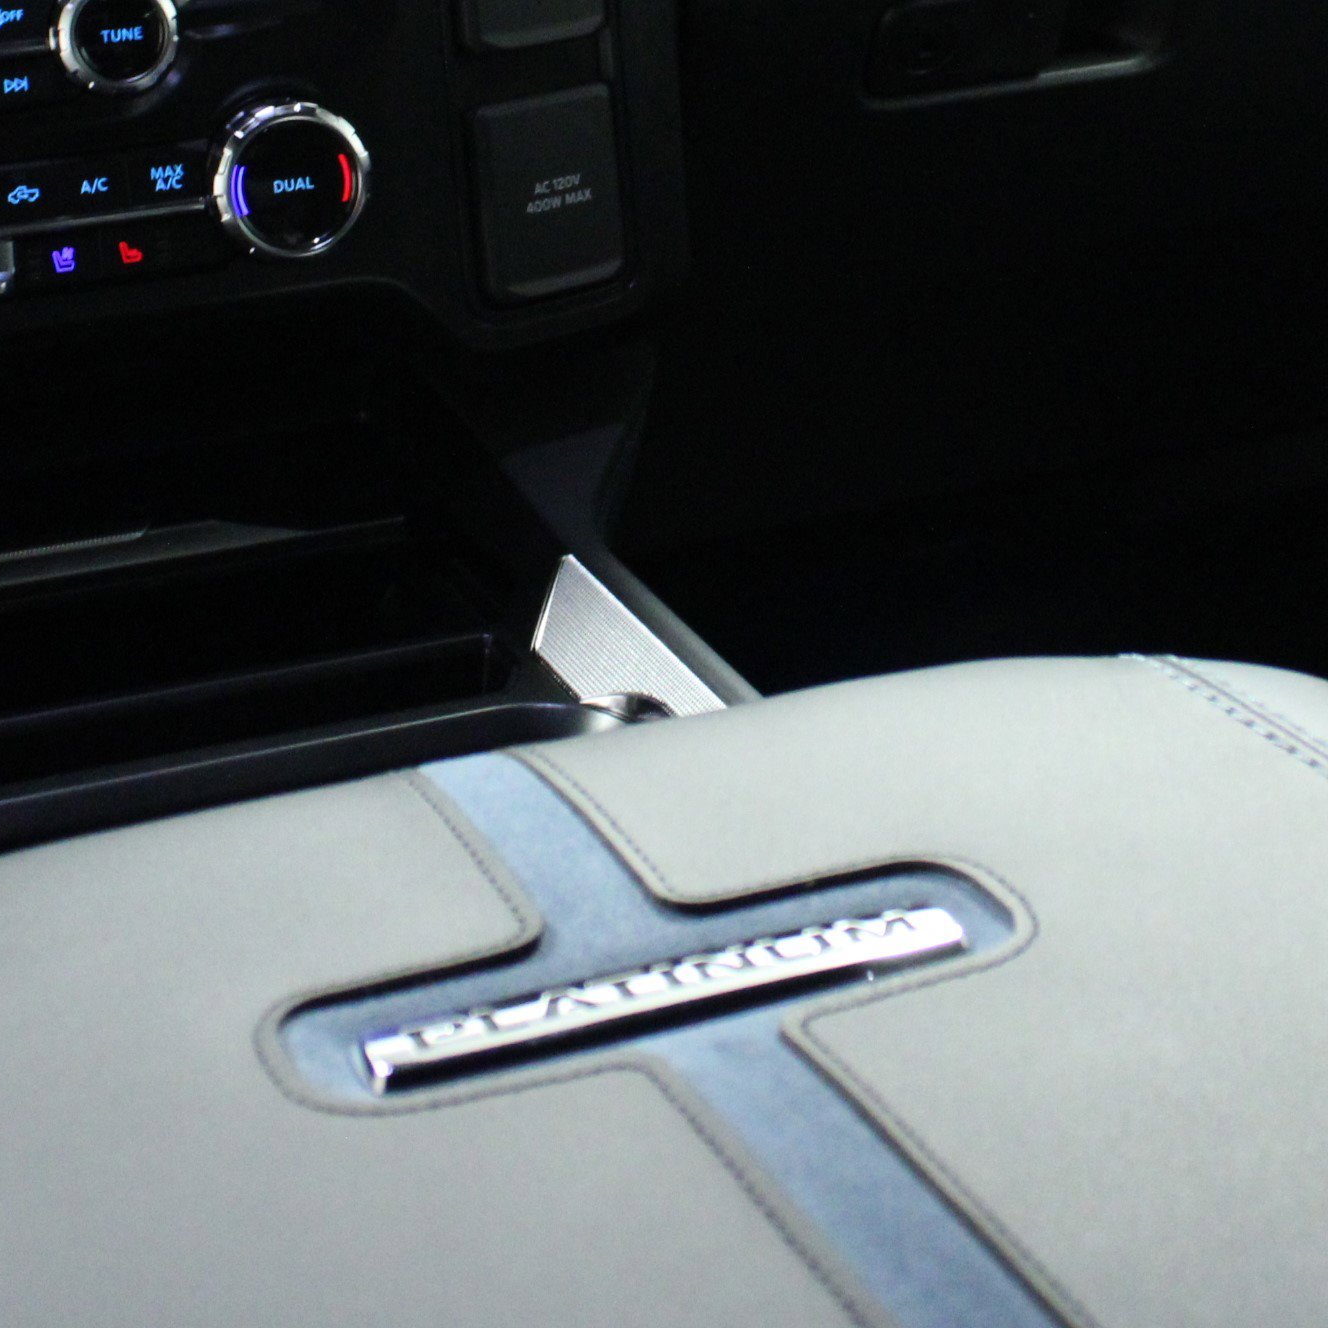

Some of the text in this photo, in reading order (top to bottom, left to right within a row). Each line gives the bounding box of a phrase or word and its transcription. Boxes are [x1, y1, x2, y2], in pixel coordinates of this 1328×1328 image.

[2, 8, 24, 23] OFF
[100, 25, 145, 44] TUNE
[150, 163, 185, 180] MAX
[79, 176, 110, 195] A/C
[154, 174, 184, 191] A/C
[273, 175, 316, 194] DUAL
[534, 173, 581, 194] AC 120V
[526, 188, 593, 213] 400W MAX
[405, 908, 918, 1050] PLATINUM
